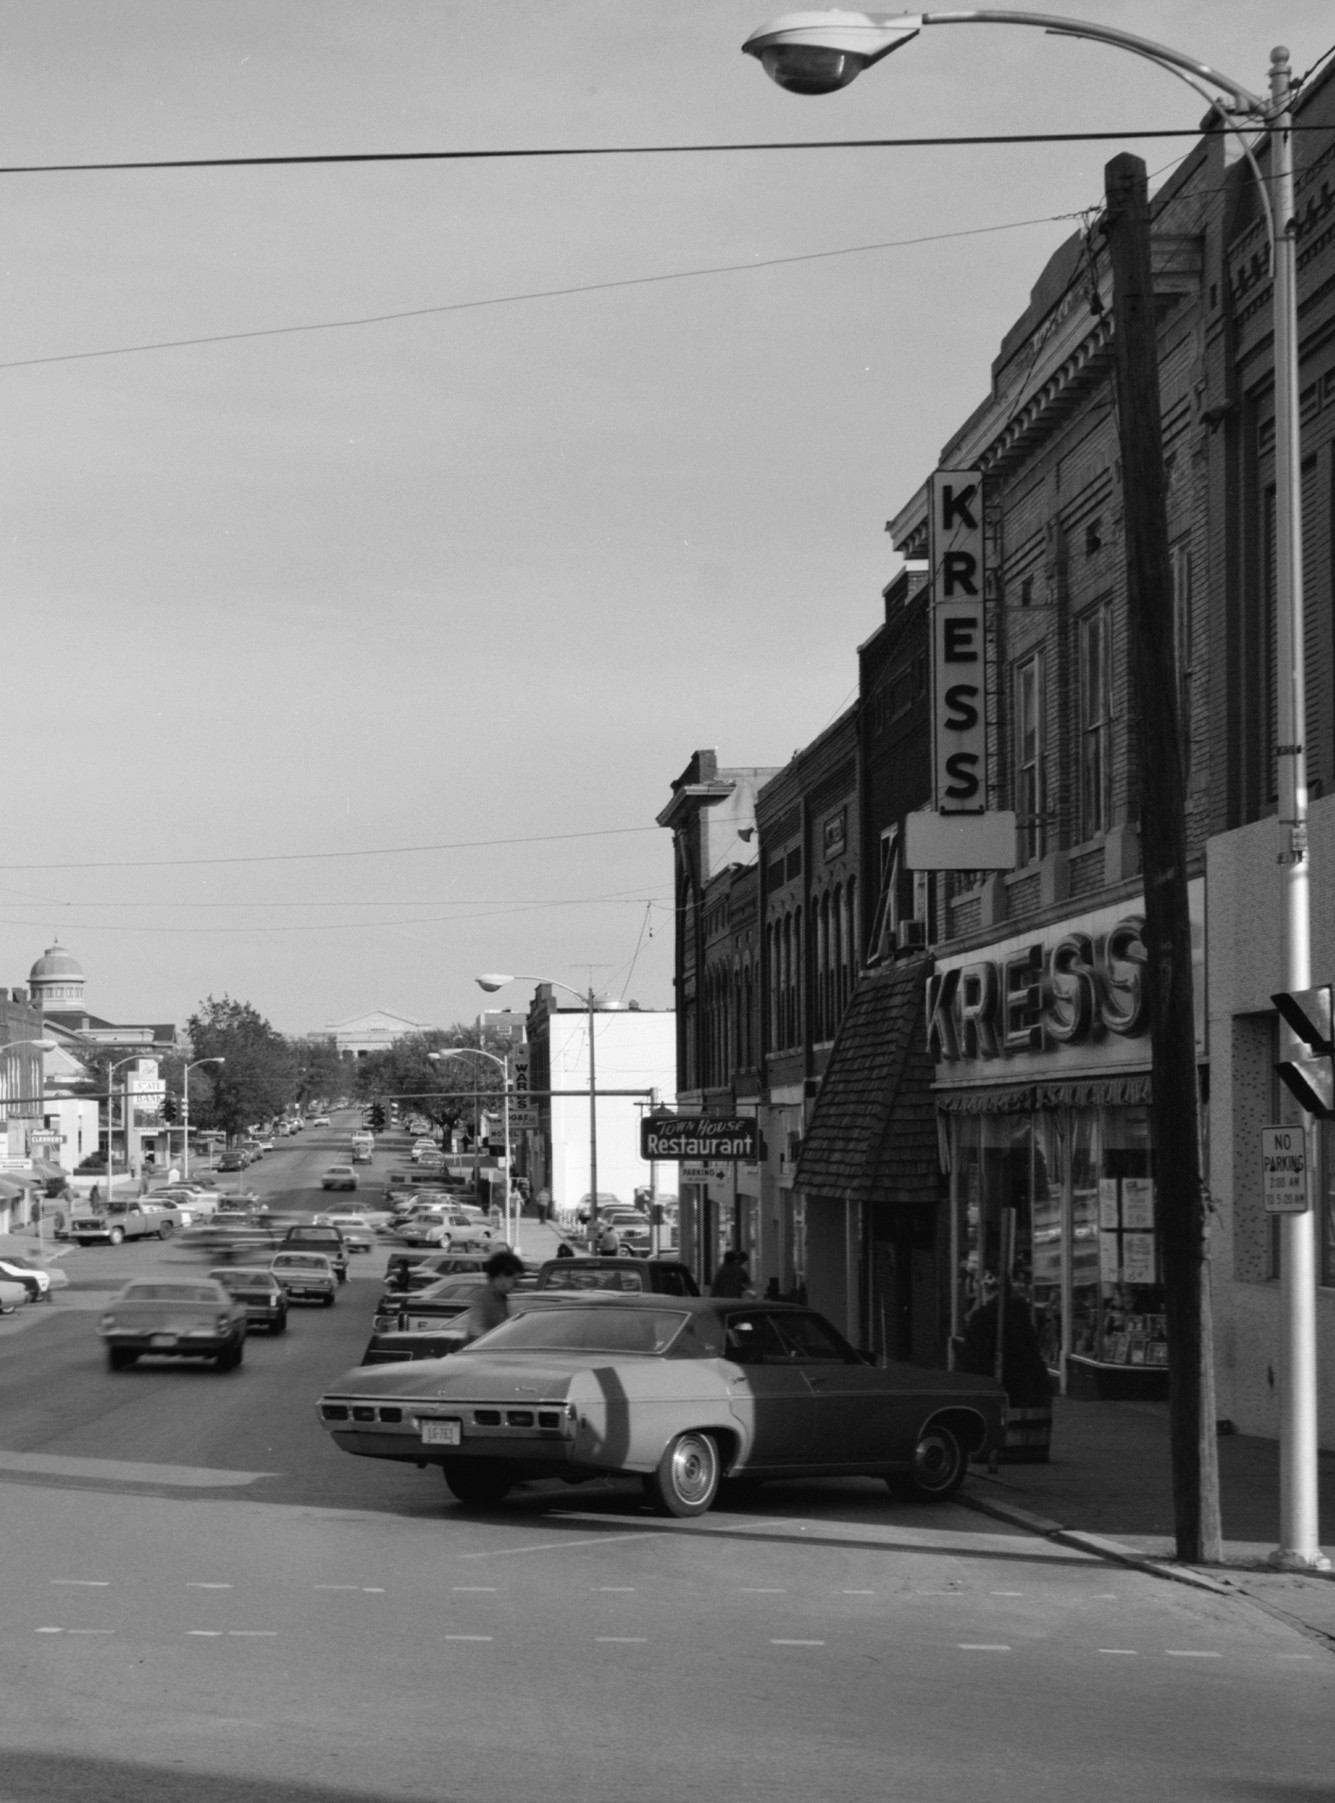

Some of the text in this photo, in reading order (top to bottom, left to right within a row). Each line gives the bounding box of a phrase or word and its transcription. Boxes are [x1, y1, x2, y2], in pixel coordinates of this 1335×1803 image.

[942, 484, 980, 800] KRESS
[926, 913, 1149, 1061] KRESS
[656, 1119, 744, 1137] TOWN HOUSE
[647, 1132, 753, 1155] Restaurant
[1274, 1134, 1291, 1150] NO
[1264, 1154, 1304, 1170] PARKING
